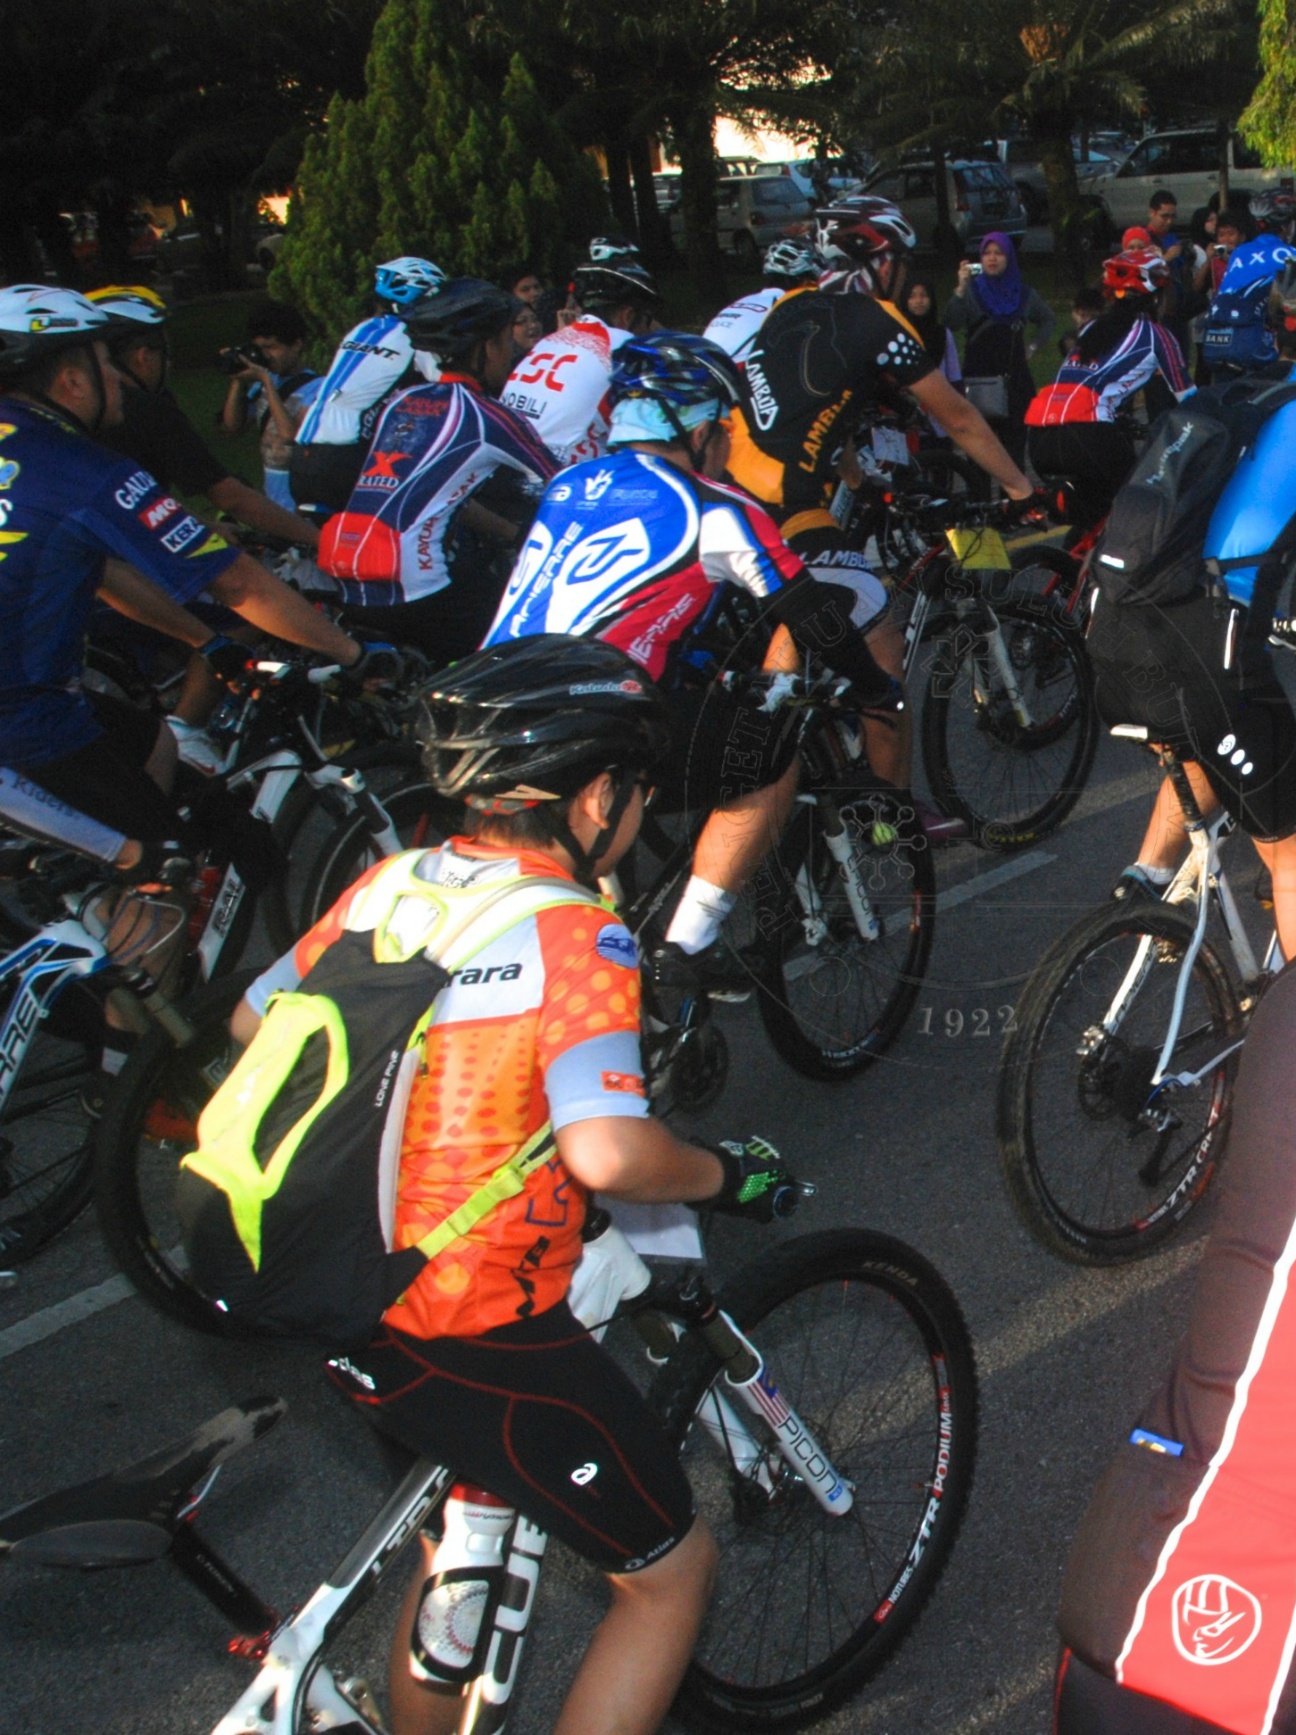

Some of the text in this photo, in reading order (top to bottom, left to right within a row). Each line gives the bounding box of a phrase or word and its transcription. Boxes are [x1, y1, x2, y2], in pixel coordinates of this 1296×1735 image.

[341, 340, 400, 361] GIANT
[359, 476, 401, 488] RATED
[862, 1260, 919, 1287] KENDA
[933, 1411, 953, 1493] PODIUM
